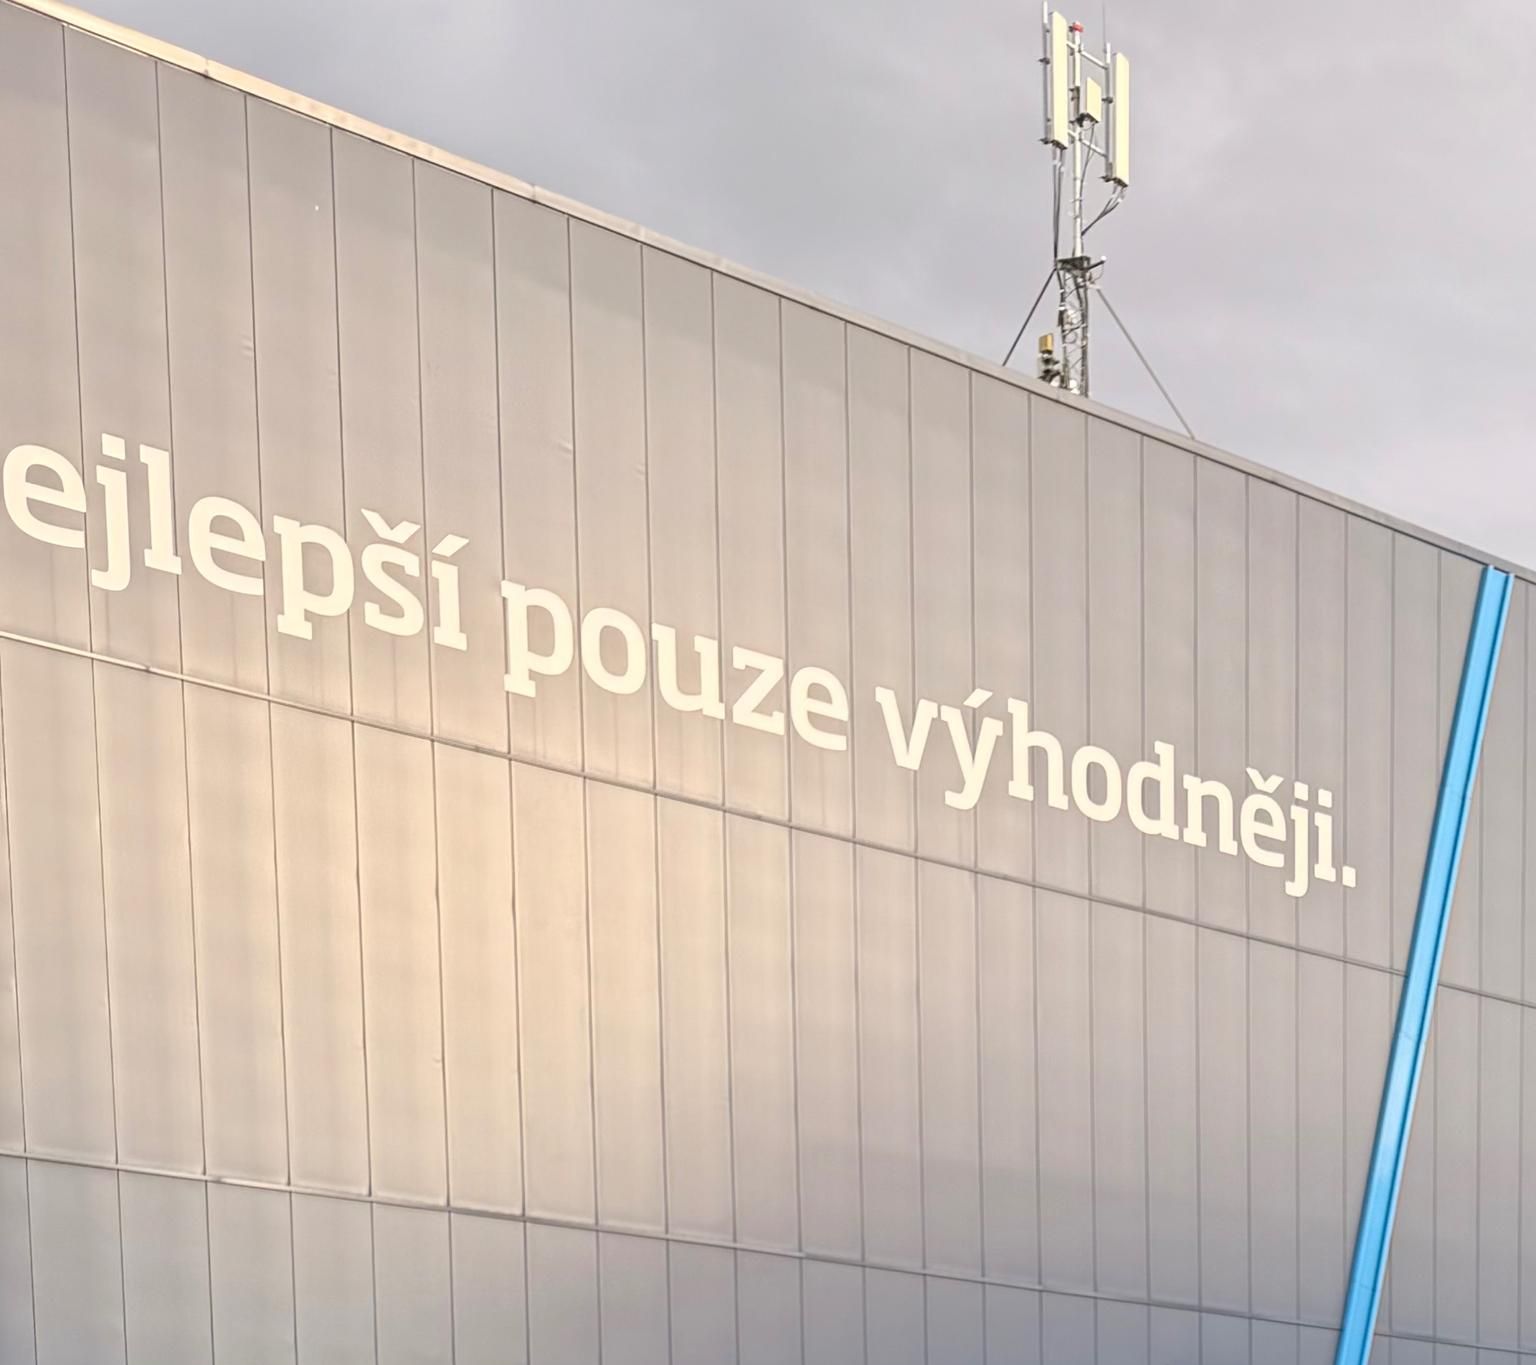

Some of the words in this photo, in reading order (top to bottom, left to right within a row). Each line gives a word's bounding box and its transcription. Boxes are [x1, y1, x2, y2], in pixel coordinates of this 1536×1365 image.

[2, 432, 469, 651] ejlepší
[501, 579, 850, 752] pouze
[875, 685, 1357, 898] výhodněji.
